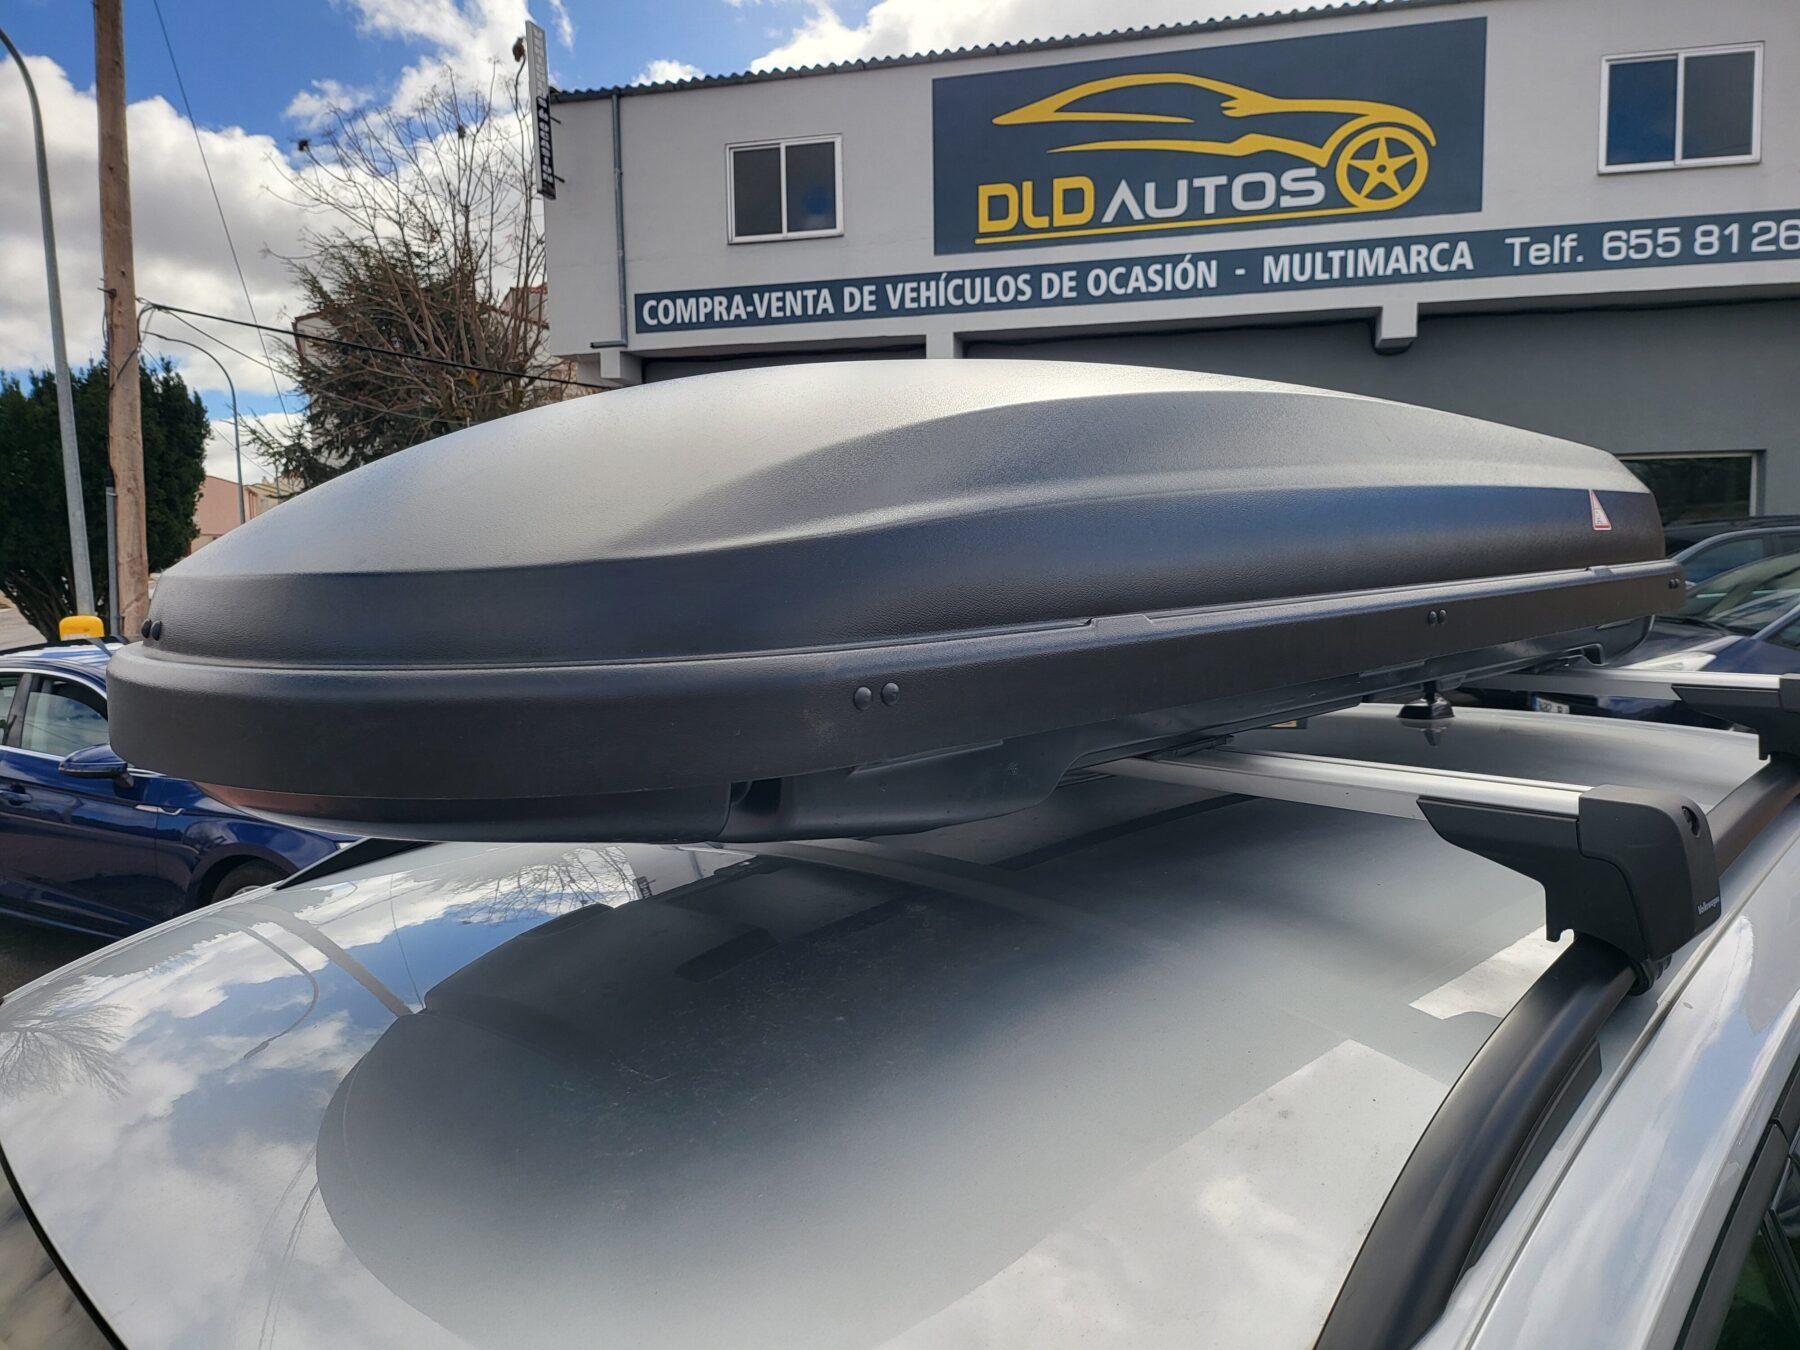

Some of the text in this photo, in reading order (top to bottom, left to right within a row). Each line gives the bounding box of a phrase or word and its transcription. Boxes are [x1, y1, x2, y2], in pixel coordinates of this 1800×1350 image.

[978, 167, 1326, 233] DLD AUTOS
[642, 288, 835, 326] COMPRA-VENTA
[843, 285, 877, 313] DE
[885, 272, 1032, 310] VEHÍCULOS
[1041, 270, 1077, 300] DE
[1087, 254, 1218, 297] OCASIÓN
[1263, 240, 1474, 284] MULTIMARCA
[1504, 233, 1584, 267] Telf.
[1602, 226, 1682, 261] 655
